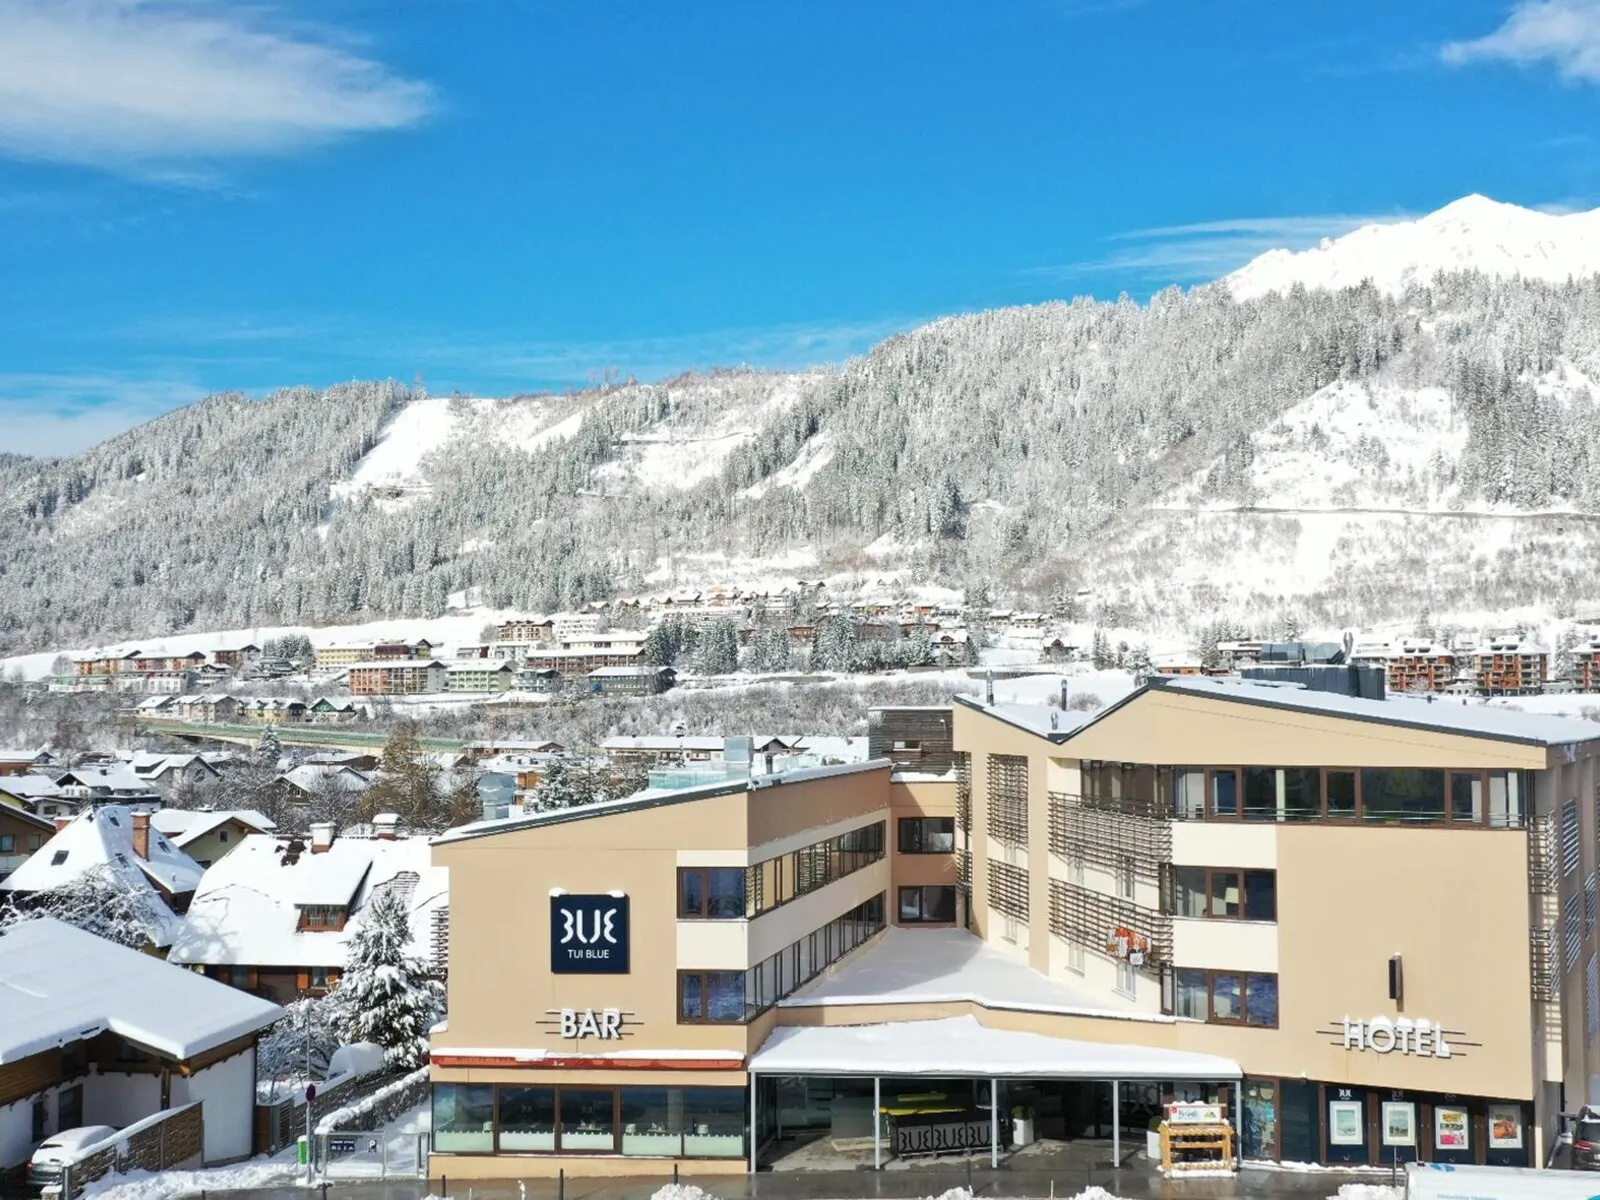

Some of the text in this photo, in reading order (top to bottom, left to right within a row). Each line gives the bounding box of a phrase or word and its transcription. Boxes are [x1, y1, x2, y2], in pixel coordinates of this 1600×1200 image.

[568, 950, 610, 959] TUI BLUE
[560, 1008, 622, 1039] BAR
[1343, 1017, 1452, 1059] HOTEL
